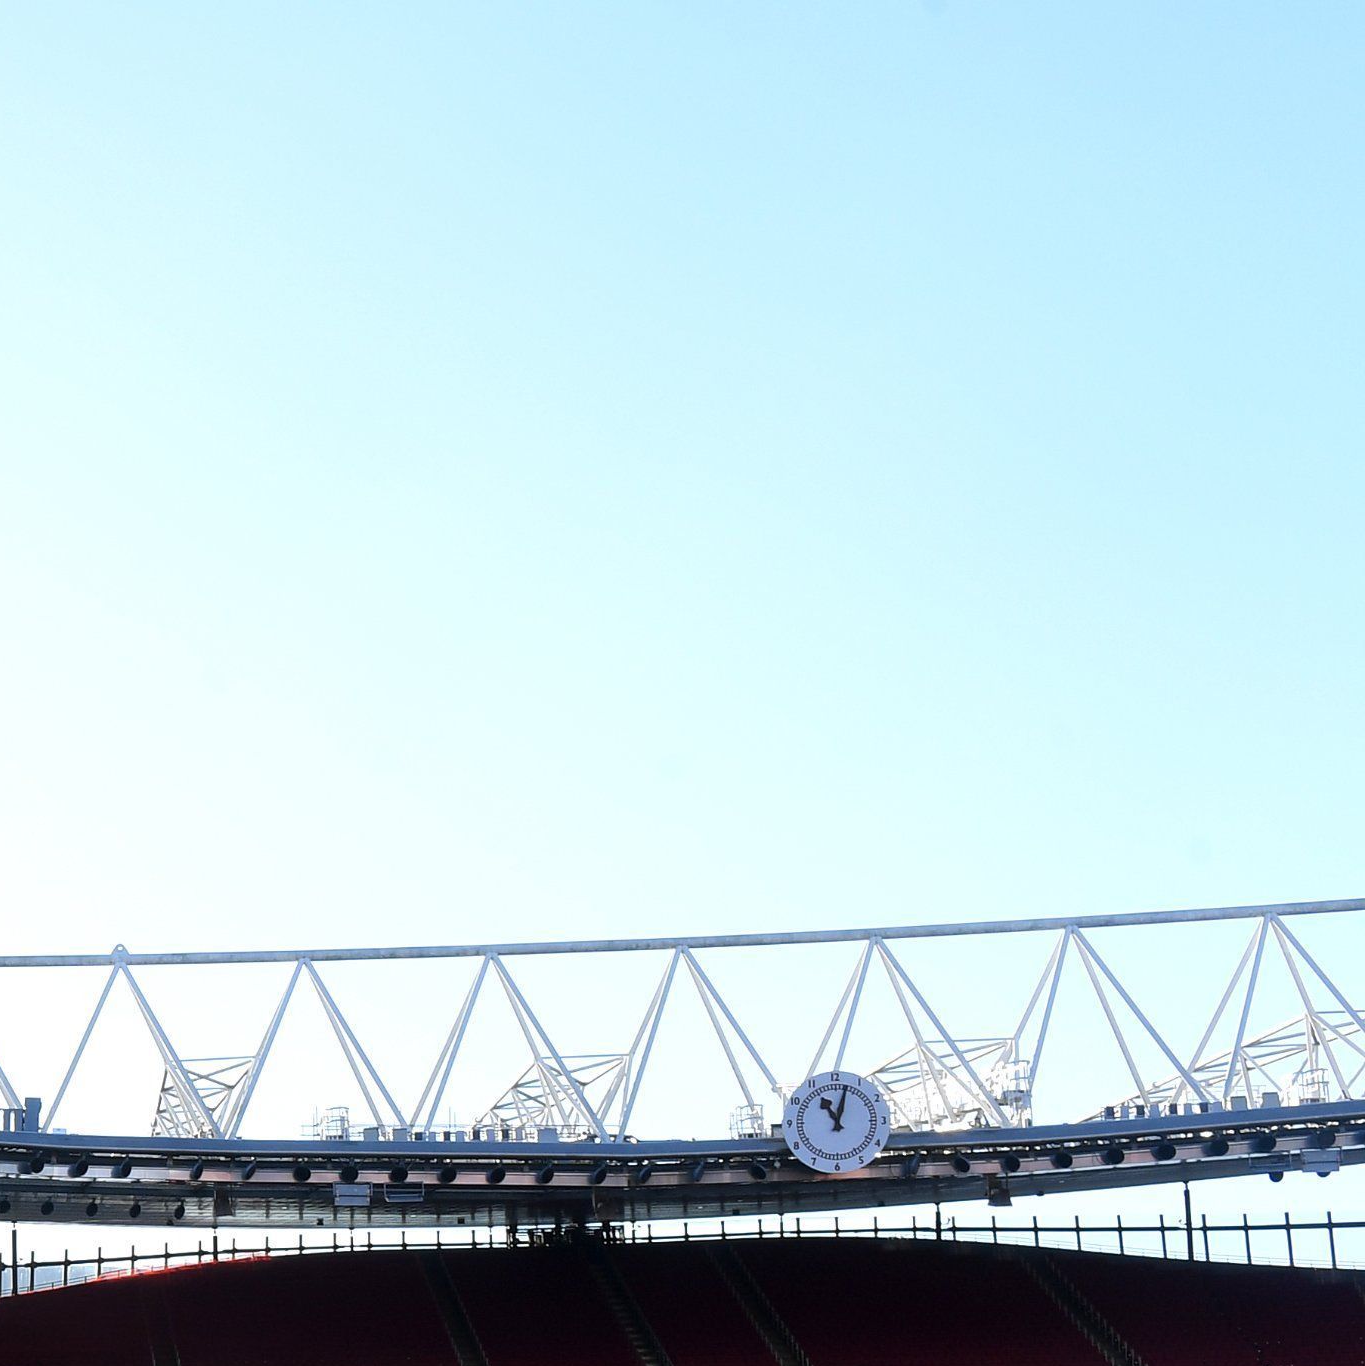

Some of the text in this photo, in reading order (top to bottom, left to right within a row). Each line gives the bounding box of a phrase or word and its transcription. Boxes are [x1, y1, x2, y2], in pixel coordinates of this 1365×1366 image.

[831, 1073, 840, 1082] 12
[809, 1080, 815, 1088] 11
[791, 1097, 800, 1105] 10
[874, 1094, 880, 1102] 2
[787, 1119, 792, 1128] 9
[881, 1116, 887, 1125] 3
[794, 1141, 799, 1150] 8
[875, 1139, 881, 1147] 4
[811, 1157, 816, 1166] 7
[858, 1156, 864, 1164] 5
[835, 1163, 840, 1171] 6
